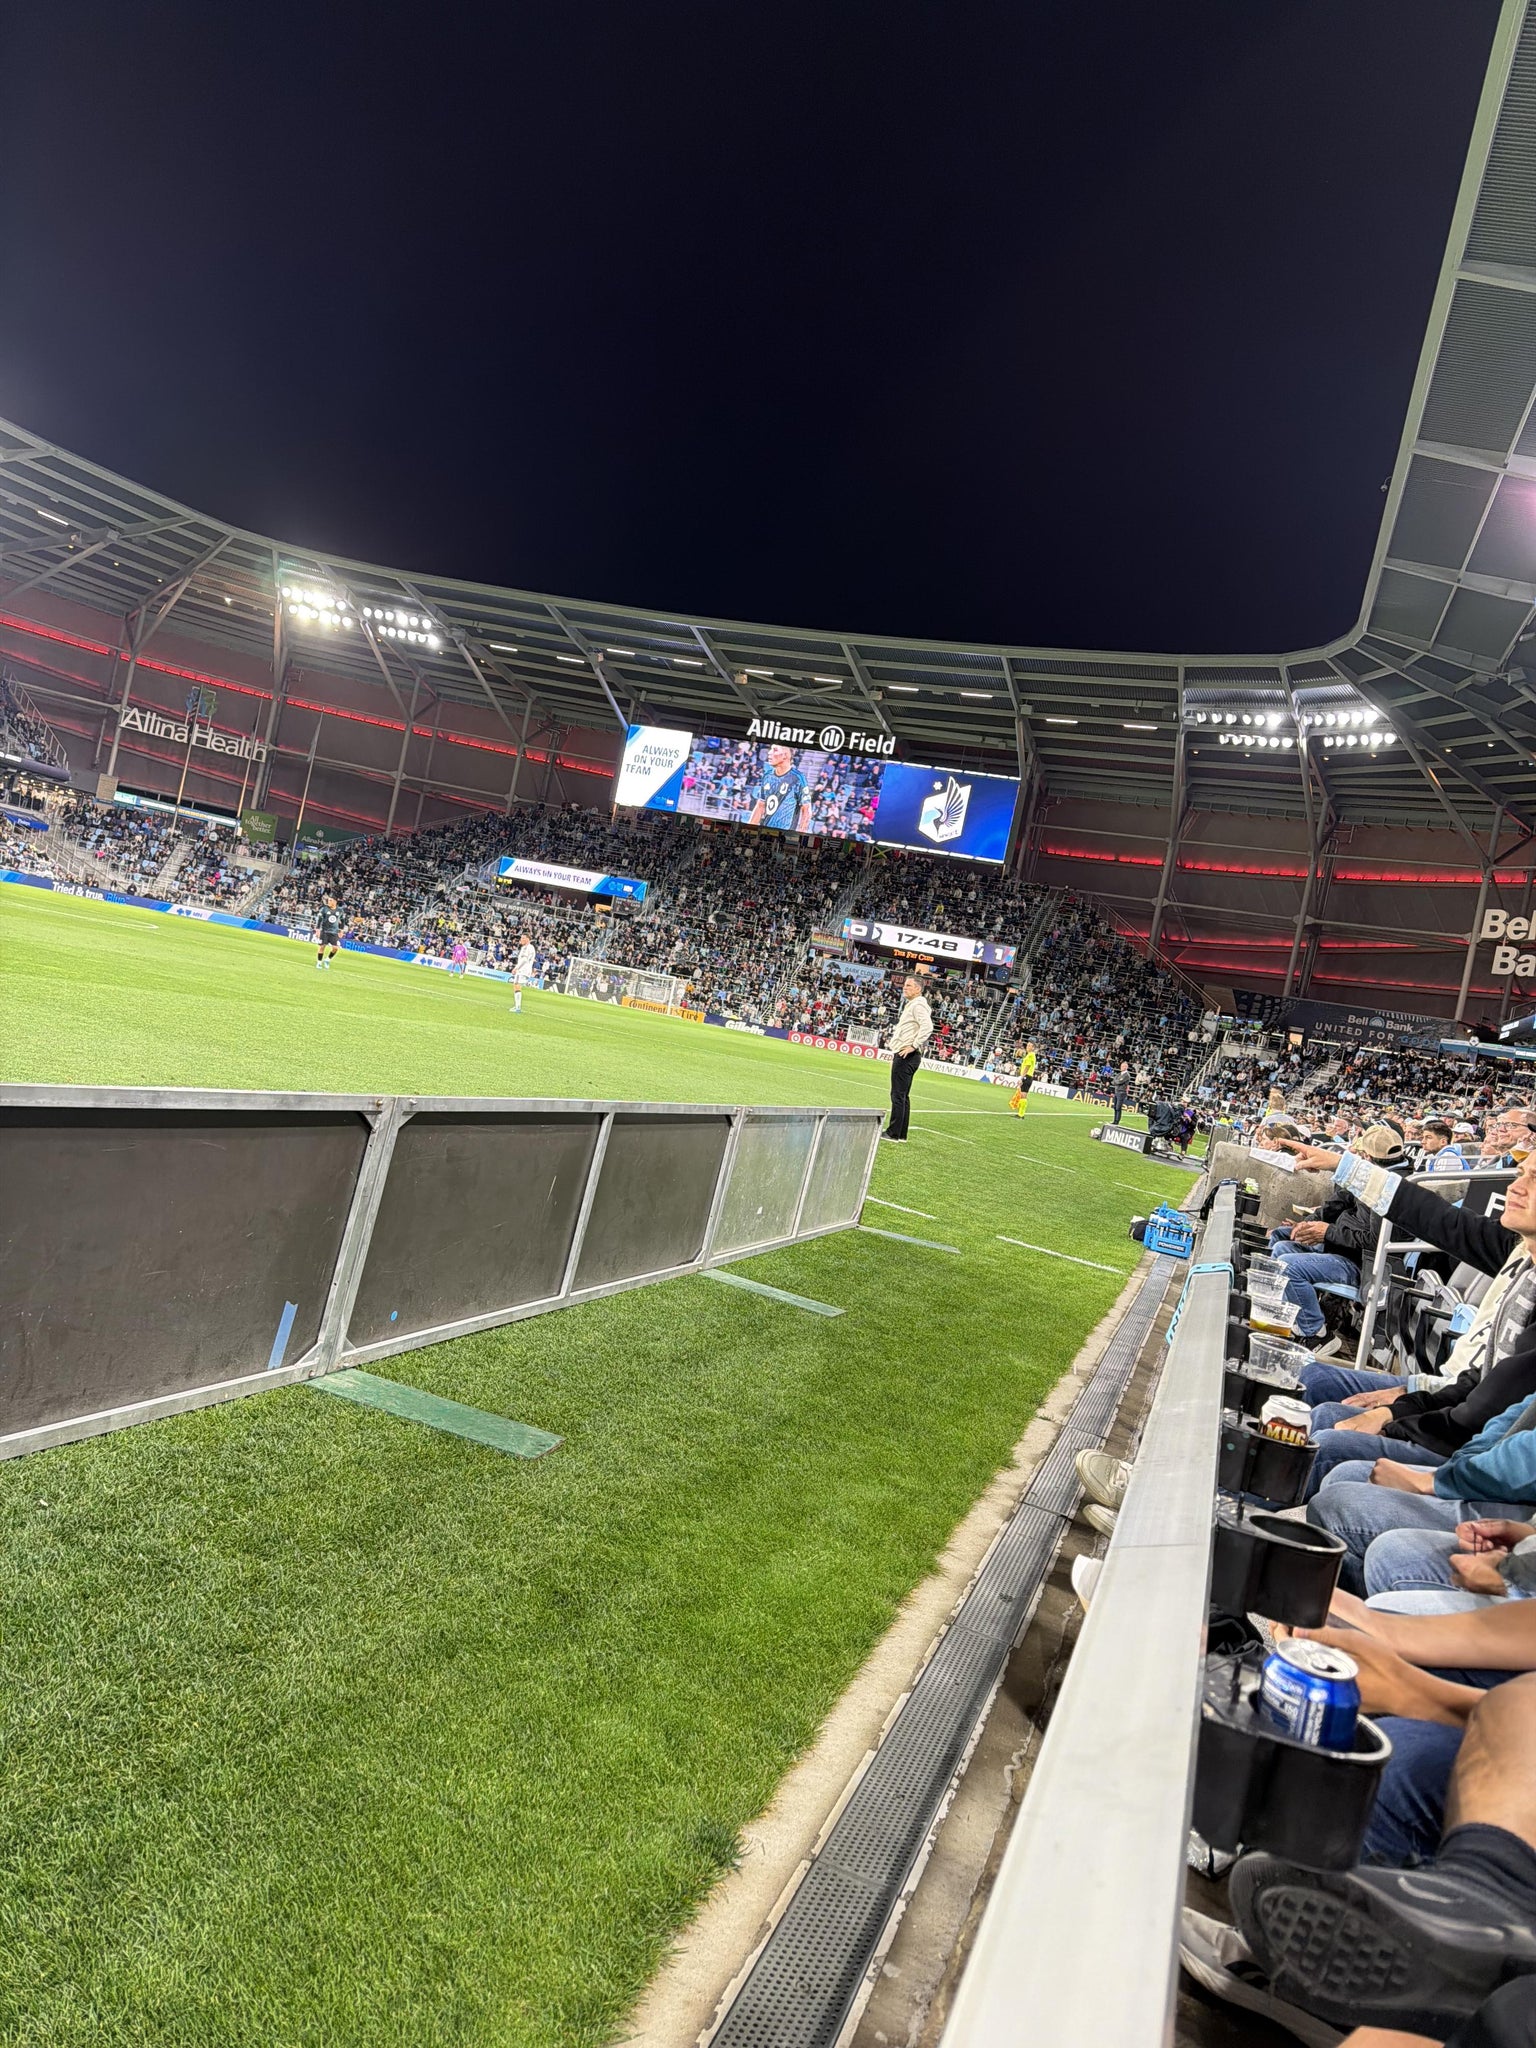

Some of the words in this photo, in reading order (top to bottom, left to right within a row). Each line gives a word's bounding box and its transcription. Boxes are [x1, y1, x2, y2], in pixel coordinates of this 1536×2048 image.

[120, 707, 188, 744] Allina
[192, 724, 268, 763] Health
[746, 718, 816, 745] Allianz
[849, 732, 896, 755] Field
[642, 744, 680, 759] ALWAYS
[625, 763, 651, 776] TEAM
[634, 755, 647, 764] ON
[650, 756, 674, 769] YOUR
[514, 865, 541, 877] ALWAYS
[542, 870, 552, 879] ON
[553, 871, 572, 883] YOUR
[572, 875, 592, 886] TEAM
[52, 881, 75, 896] Tried
[75, 887, 83, 897] &
[850, 924, 868, 937] 0
[1480, 908, 1536, 940] Bel
[287, 928, 311, 943] Tried
[897, 931, 958, 952] 17:48
[995, 948, 1003, 961] 1
[1491, 945, 1536, 977] Ba
[680, 1008, 699, 1022] Tire
[1347, 1014, 1368, 1027] Bell
[1385, 1020, 1413, 1033] Bank
[725, 1019, 766, 1036] Gillette
[1314, 1021, 1363, 1036] UNITED
[1368, 1029, 1395, 1042] FOR
[880, 1052, 893, 1062] FED
[920, 1060, 962, 1076] NSURANCE
[1033, 1085, 1059, 1097] IGHT
[1072, 1090, 1107, 1109] Allina
[1108, 1096, 1139, 1115] Heal
[1105, 1128, 1141, 1151] MNUFC
